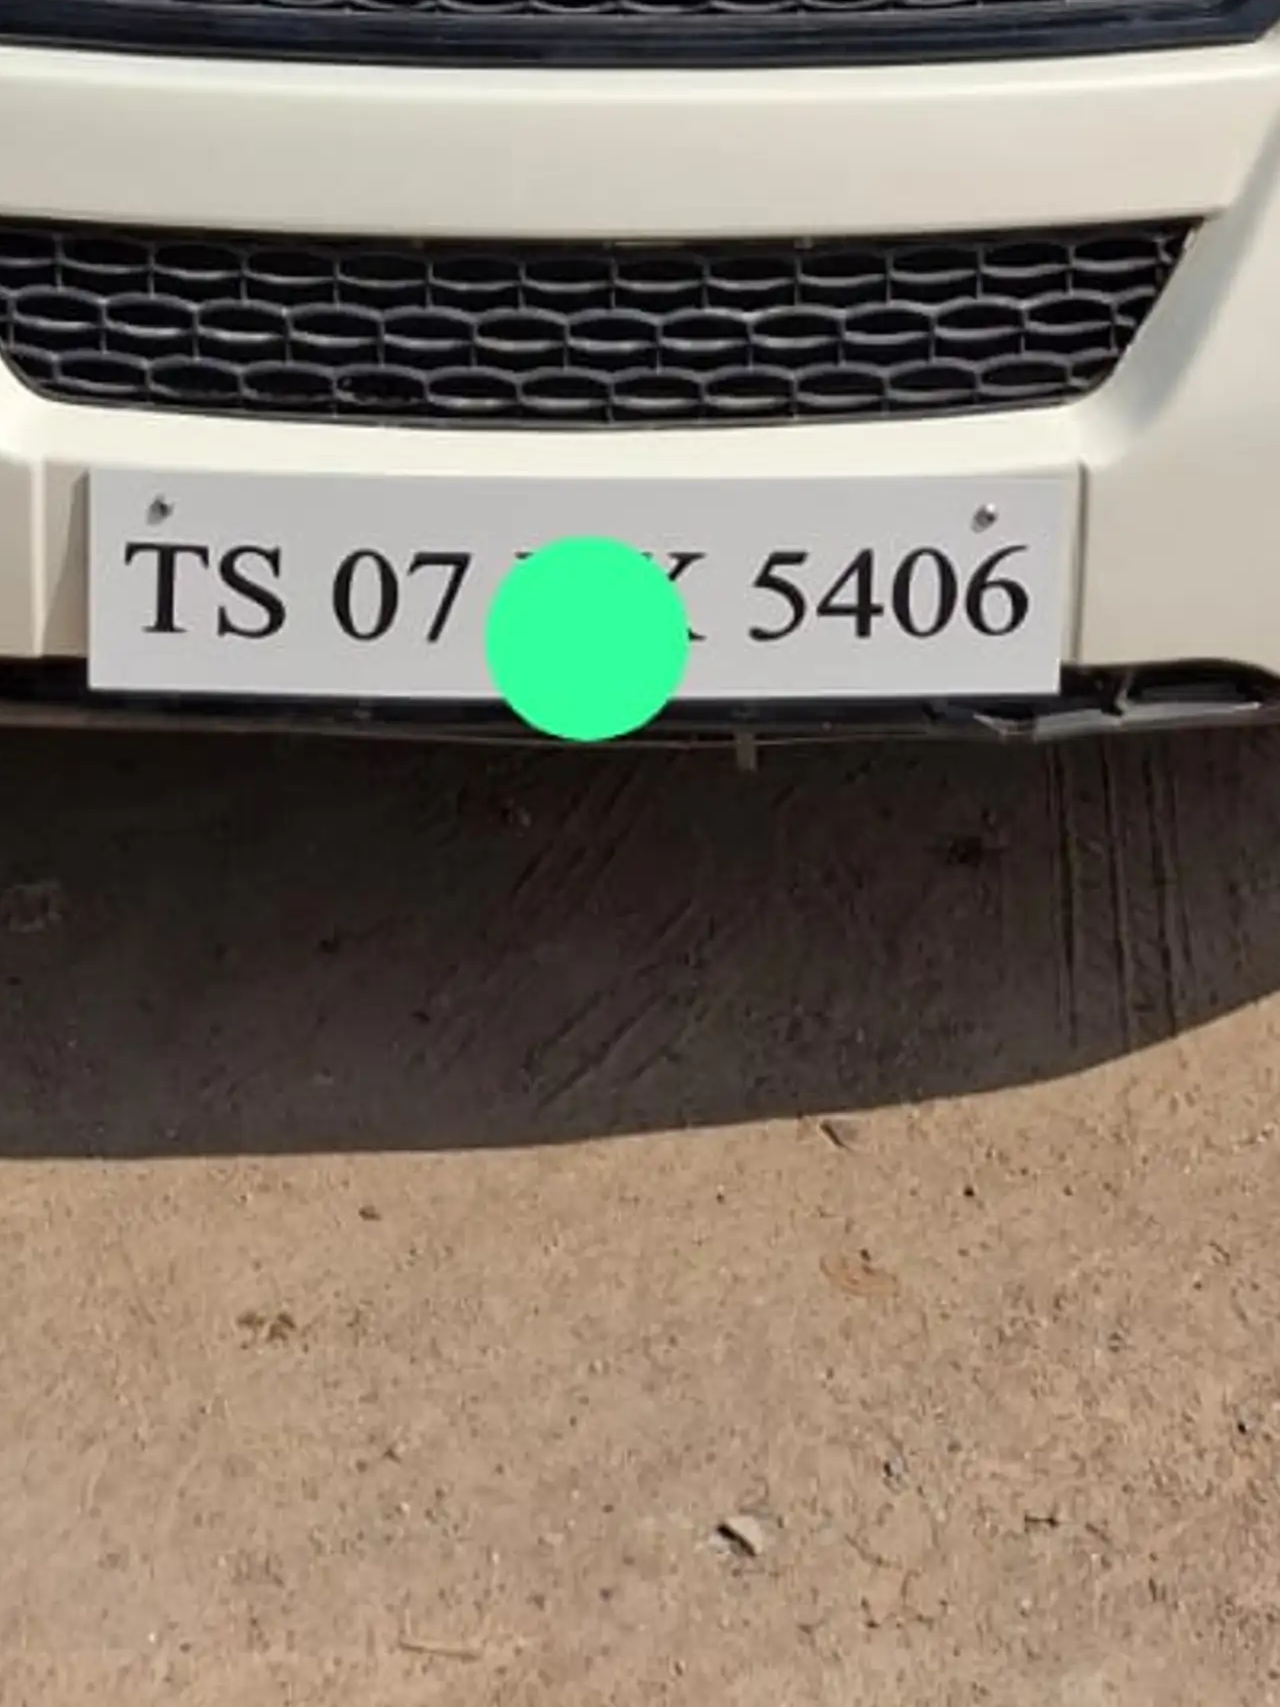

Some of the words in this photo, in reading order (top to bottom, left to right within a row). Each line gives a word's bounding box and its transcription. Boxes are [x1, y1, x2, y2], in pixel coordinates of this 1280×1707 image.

[124, 542, 286, 639] TS
[332, 548, 472, 643] 07
[748, 545, 1029, 641] 5406
